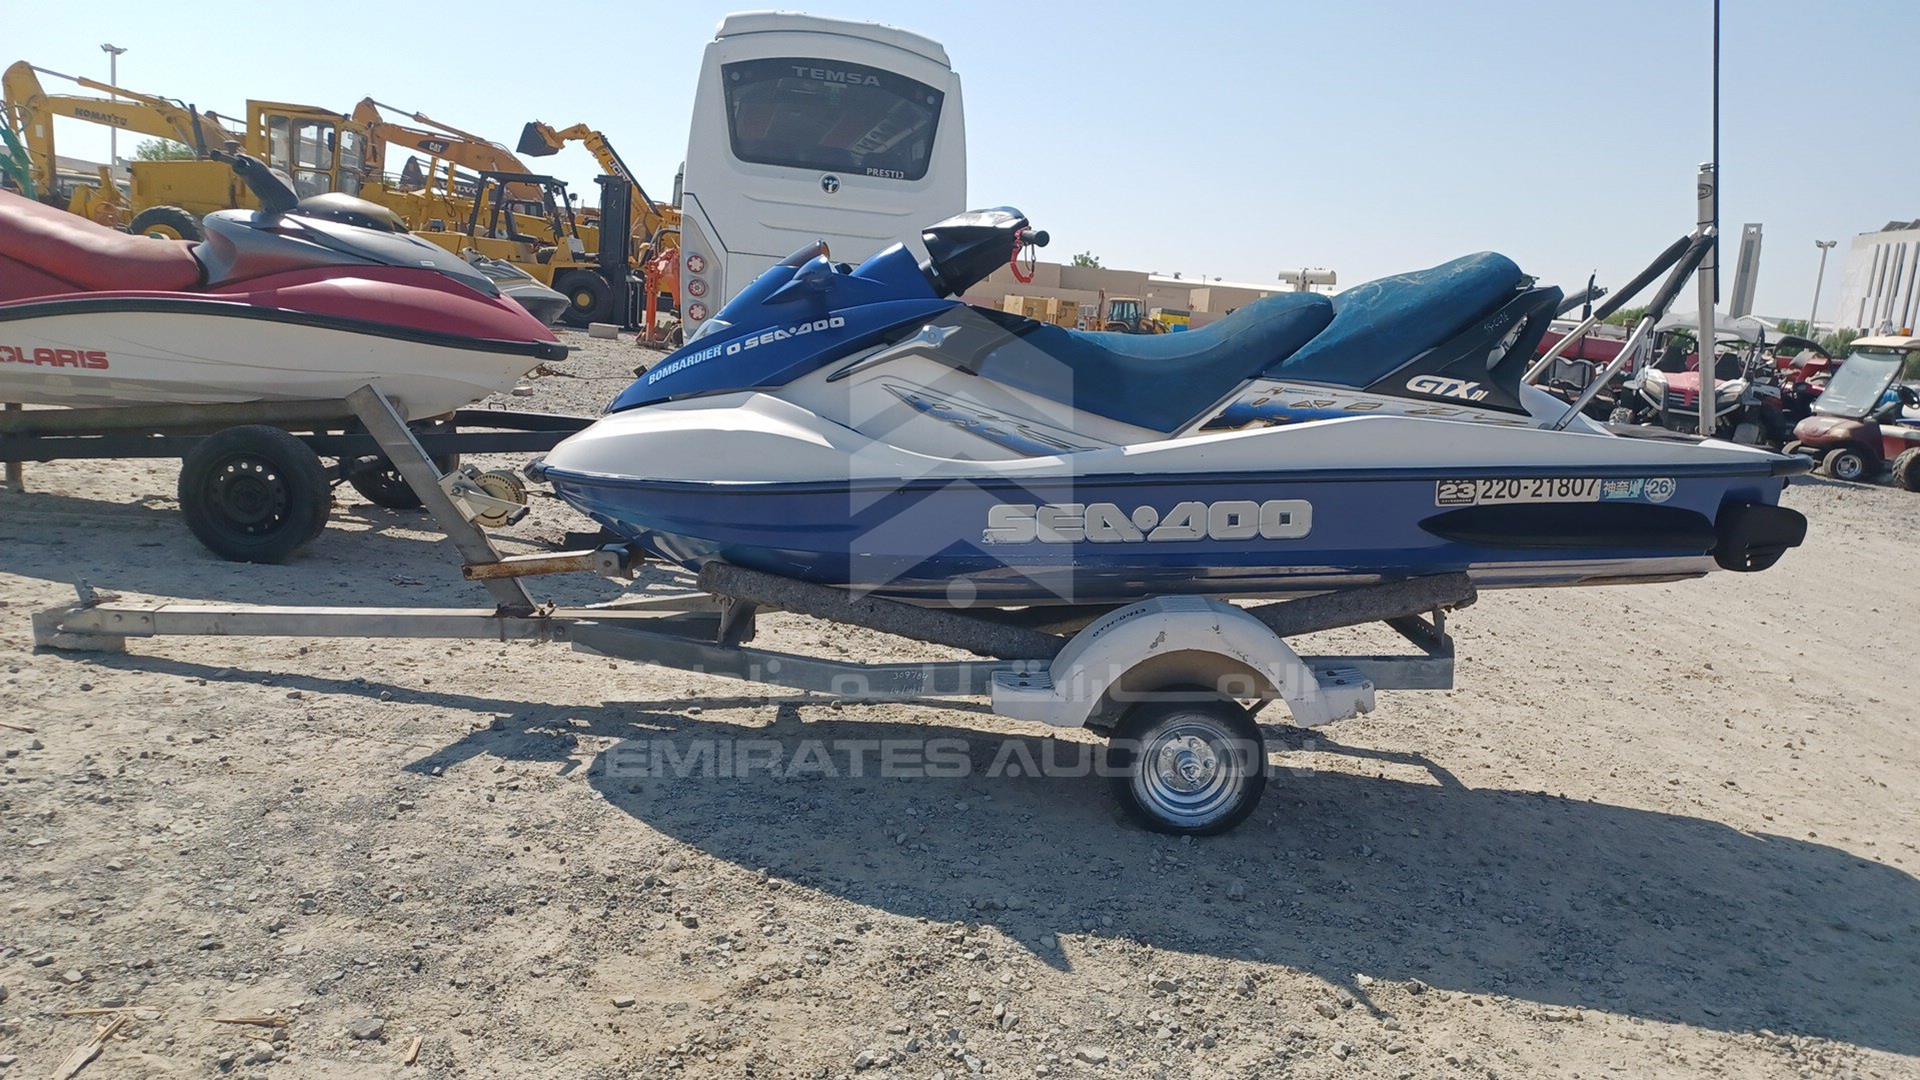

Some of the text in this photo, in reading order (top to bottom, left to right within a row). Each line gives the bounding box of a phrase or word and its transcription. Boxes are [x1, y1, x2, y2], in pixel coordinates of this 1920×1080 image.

[791, 65, 881, 87] TEMSA
[428, 141, 443, 153] CAT
[648, 344, 722, 386] BOMBARDIER
[1406, 375, 1480, 400] GTX
[1439, 478, 1597, 499] 23 220-21807
[1650, 480, 1669, 494] 26
